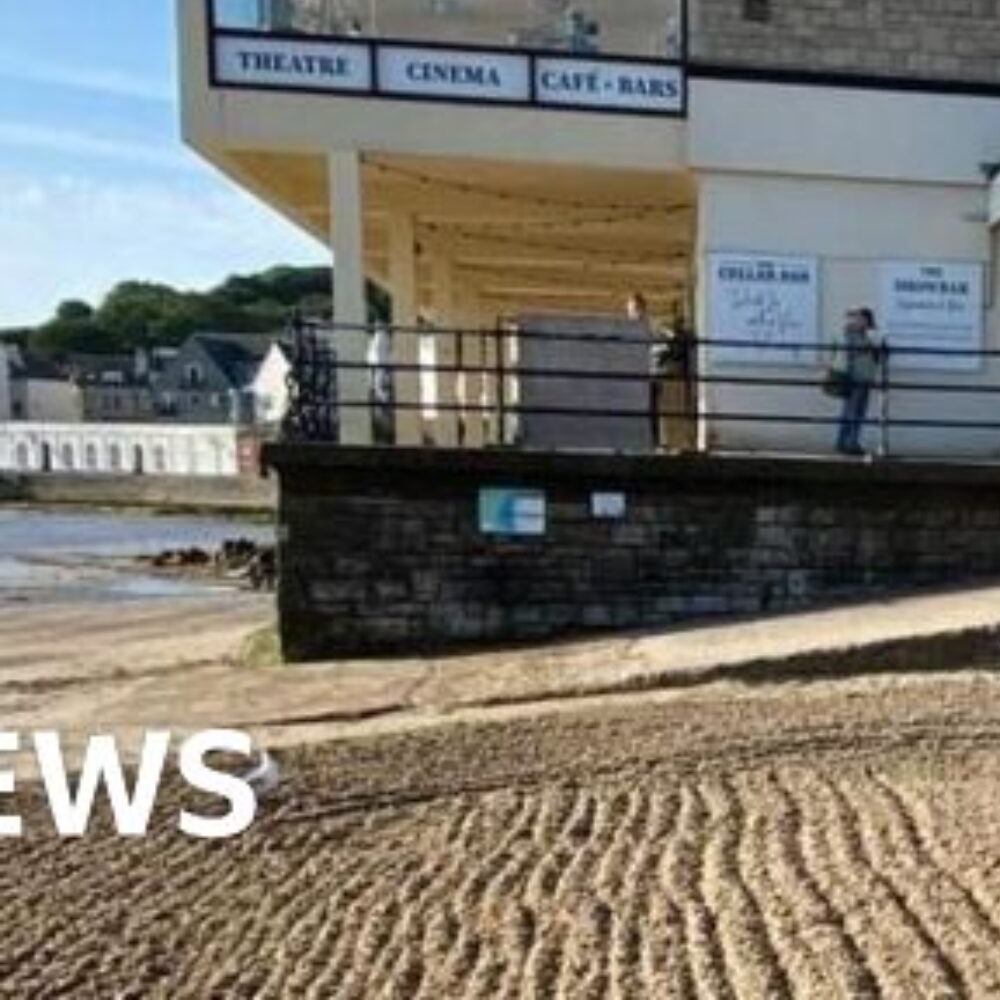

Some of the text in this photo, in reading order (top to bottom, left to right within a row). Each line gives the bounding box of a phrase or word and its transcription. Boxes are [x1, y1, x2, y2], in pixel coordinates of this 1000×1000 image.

[238, 51, 349, 76] THEATRE
[406, 62, 500, 87] CINEMA
[617, 75, 678, 98] BARS
